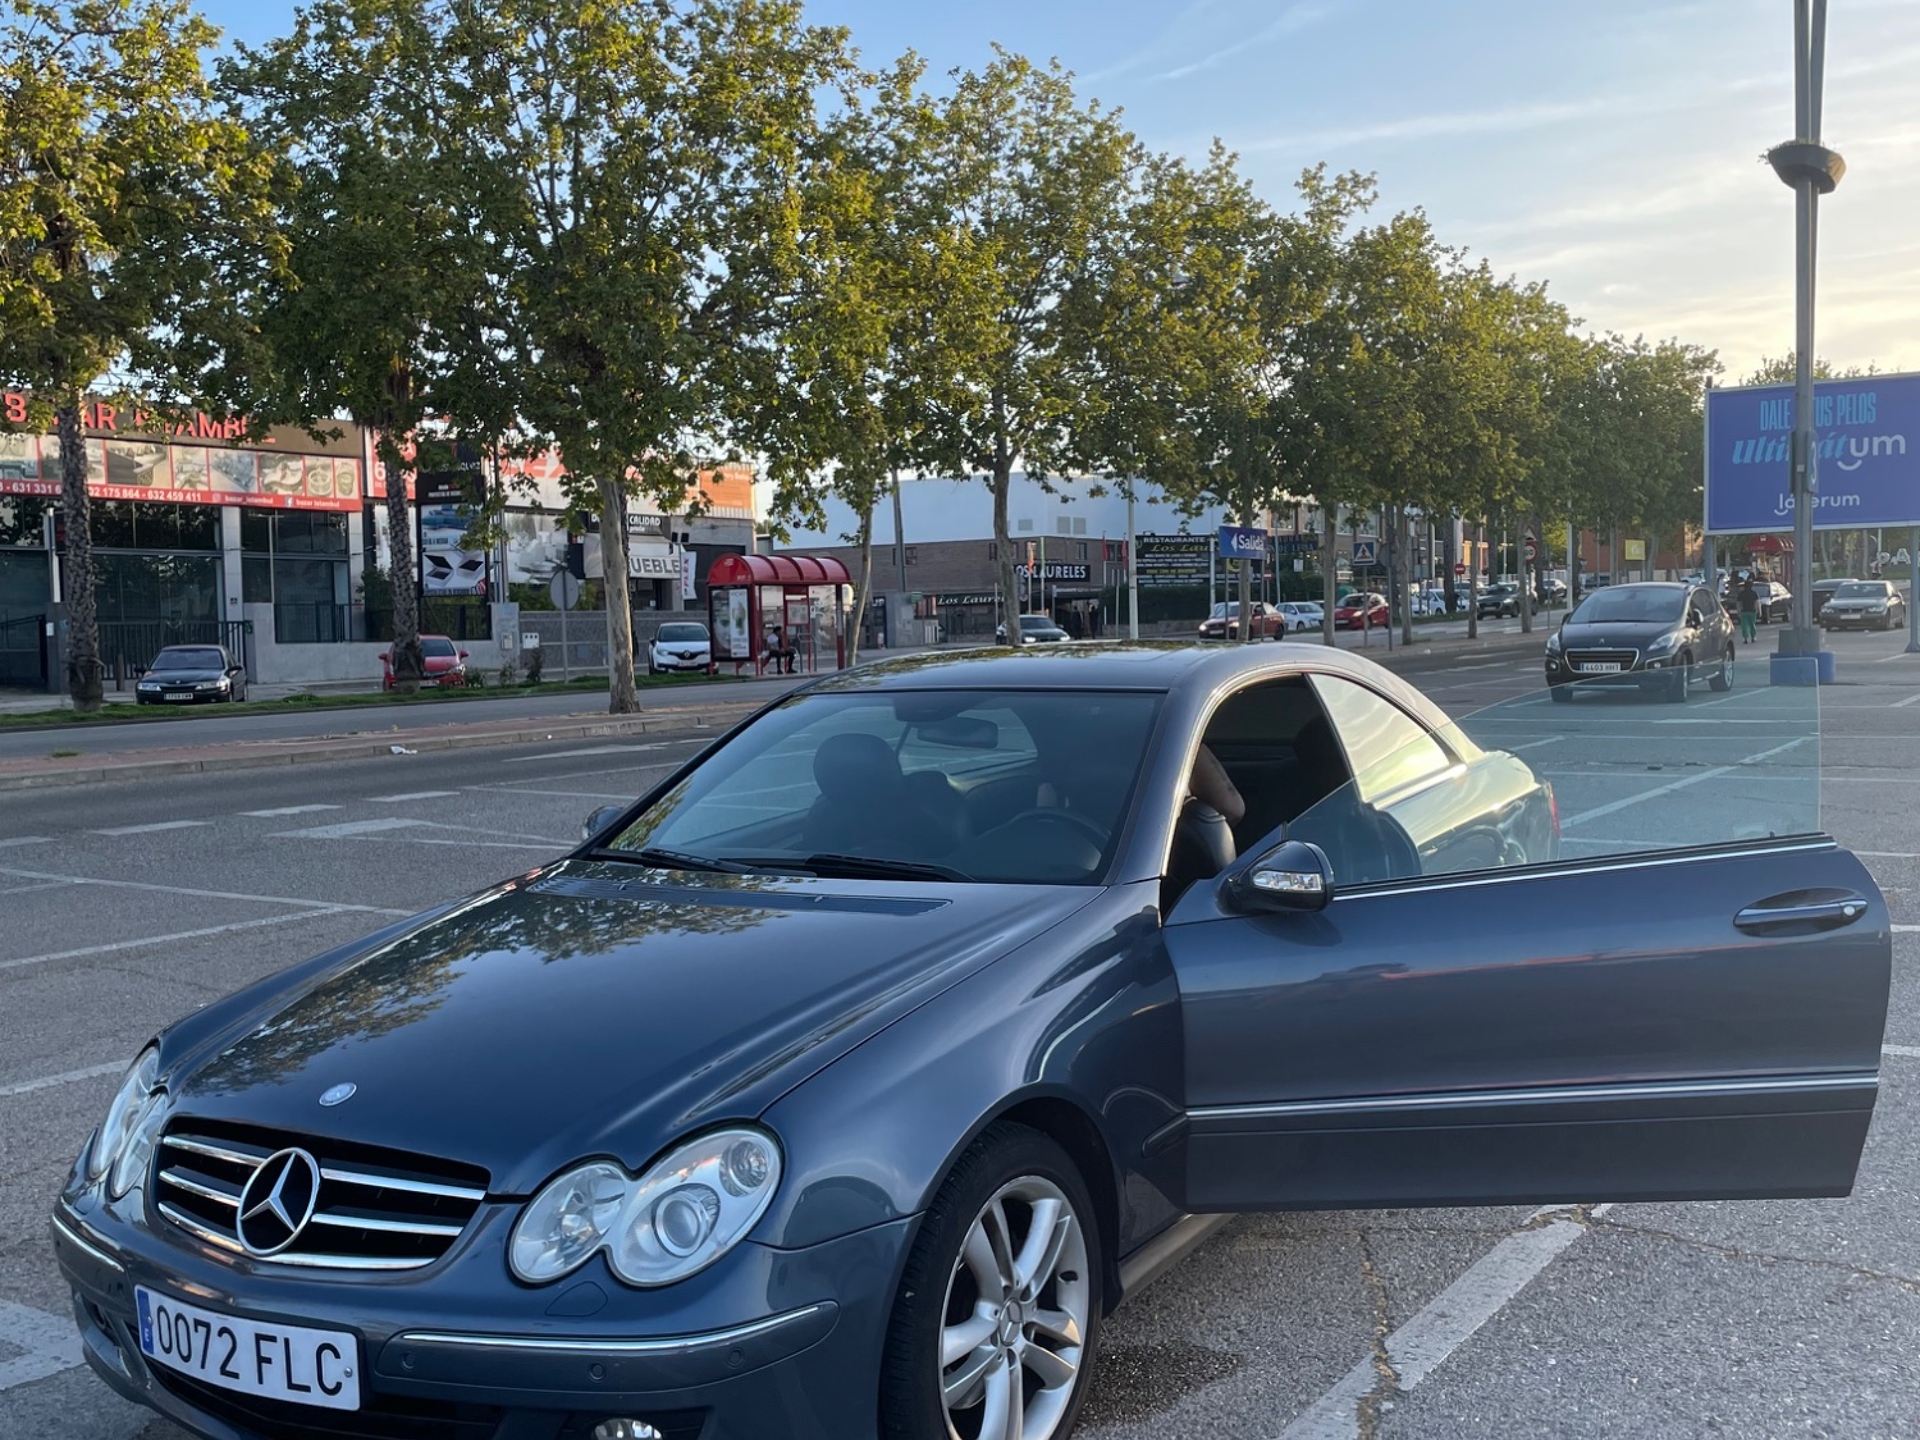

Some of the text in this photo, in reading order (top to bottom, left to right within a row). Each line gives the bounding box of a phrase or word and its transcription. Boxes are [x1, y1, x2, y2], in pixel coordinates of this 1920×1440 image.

[1760, 392, 1876, 431] DALE US PELOS
[1732, 432, 1906, 464] ultiátum
[1779, 493, 1860, 509] láerum
[1238, 533, 1265, 551] Salida
[1033, 566, 1086, 578] LAURELES
[937, 596, 959, 606] Los
[156, 1304, 343, 1397] 0072 FLC
